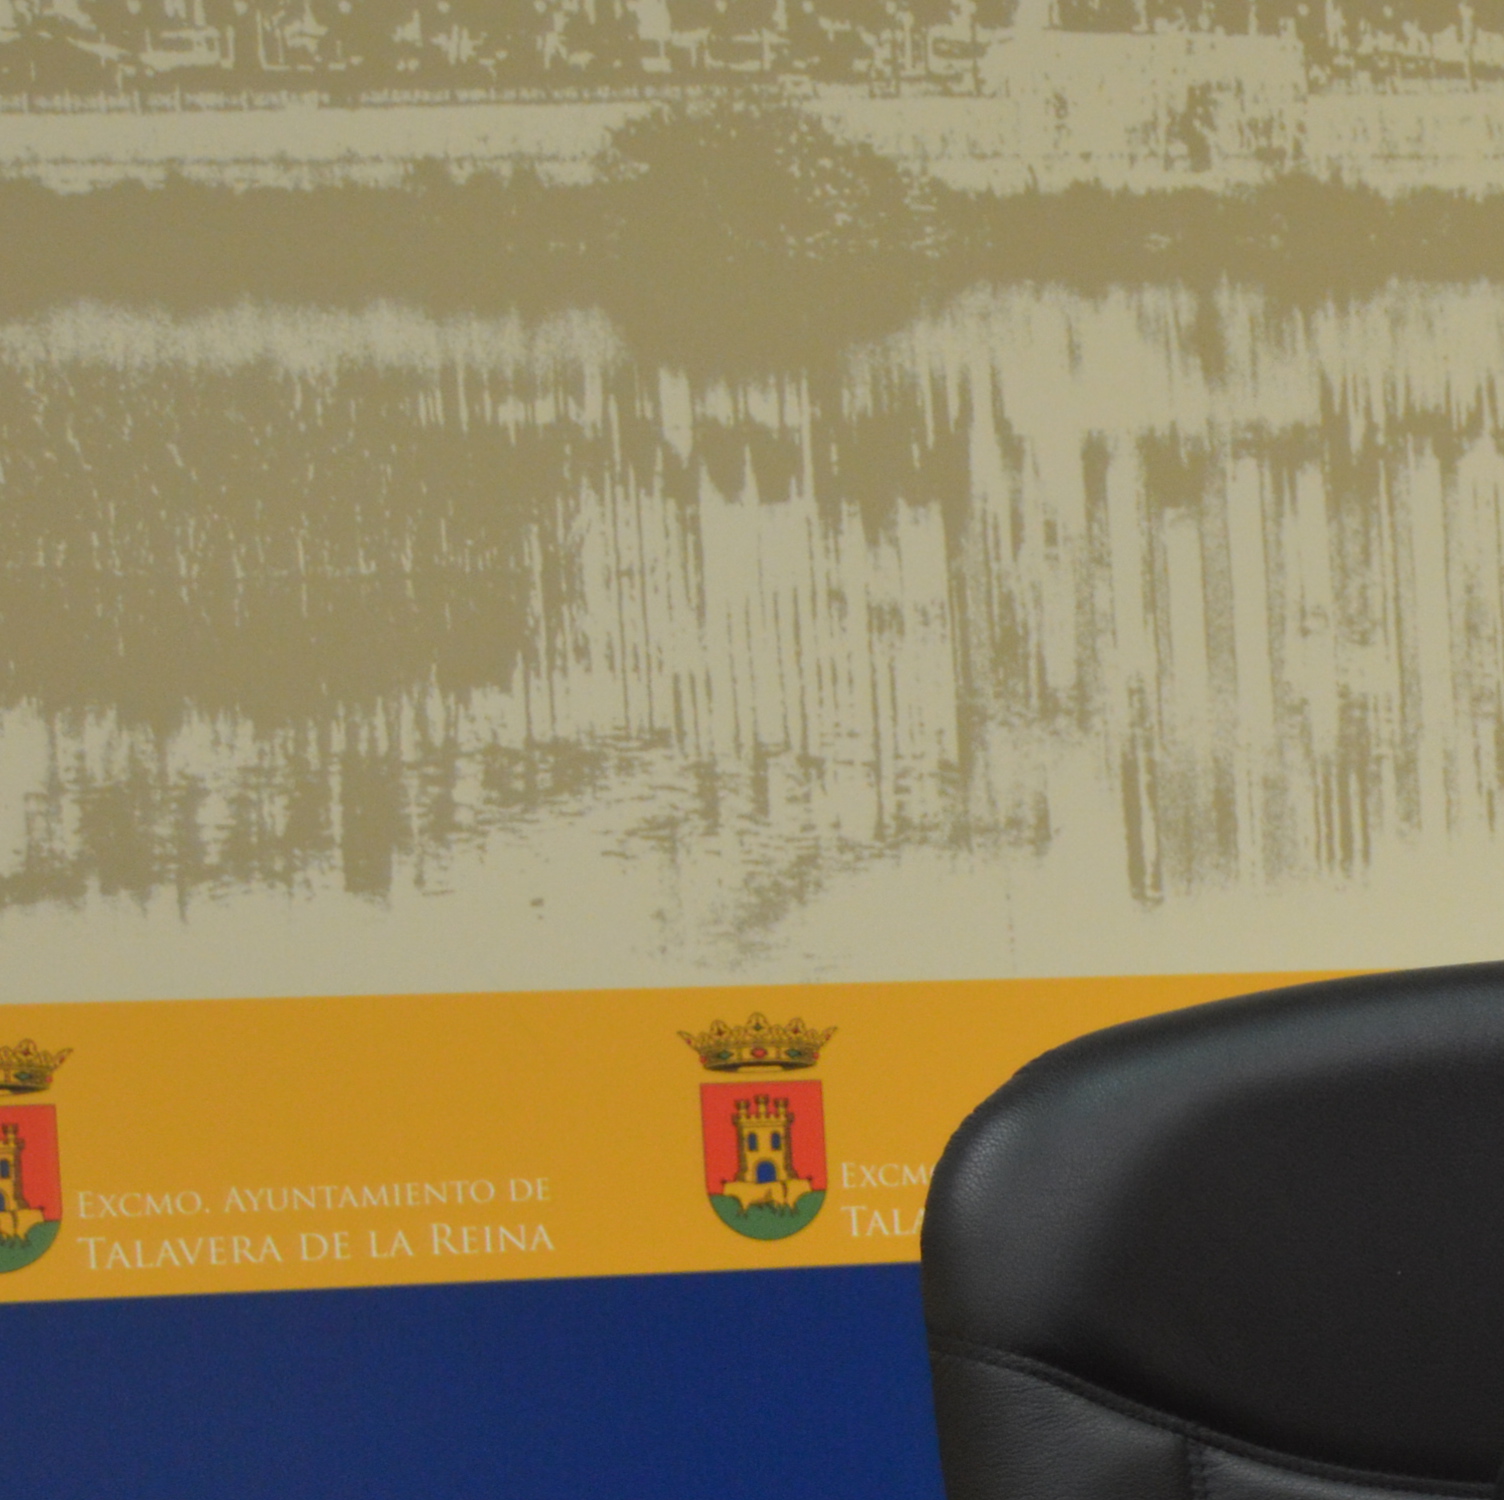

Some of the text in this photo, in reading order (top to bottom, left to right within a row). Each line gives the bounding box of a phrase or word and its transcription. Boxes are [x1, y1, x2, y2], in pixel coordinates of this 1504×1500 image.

[841, 1162, 937, 1189] EXCM
[77, 1176, 551, 1220] EXCMO. AYUNTAMIENTO DE
[76, 1222, 557, 1270] TALAVERA DE LA REINA
